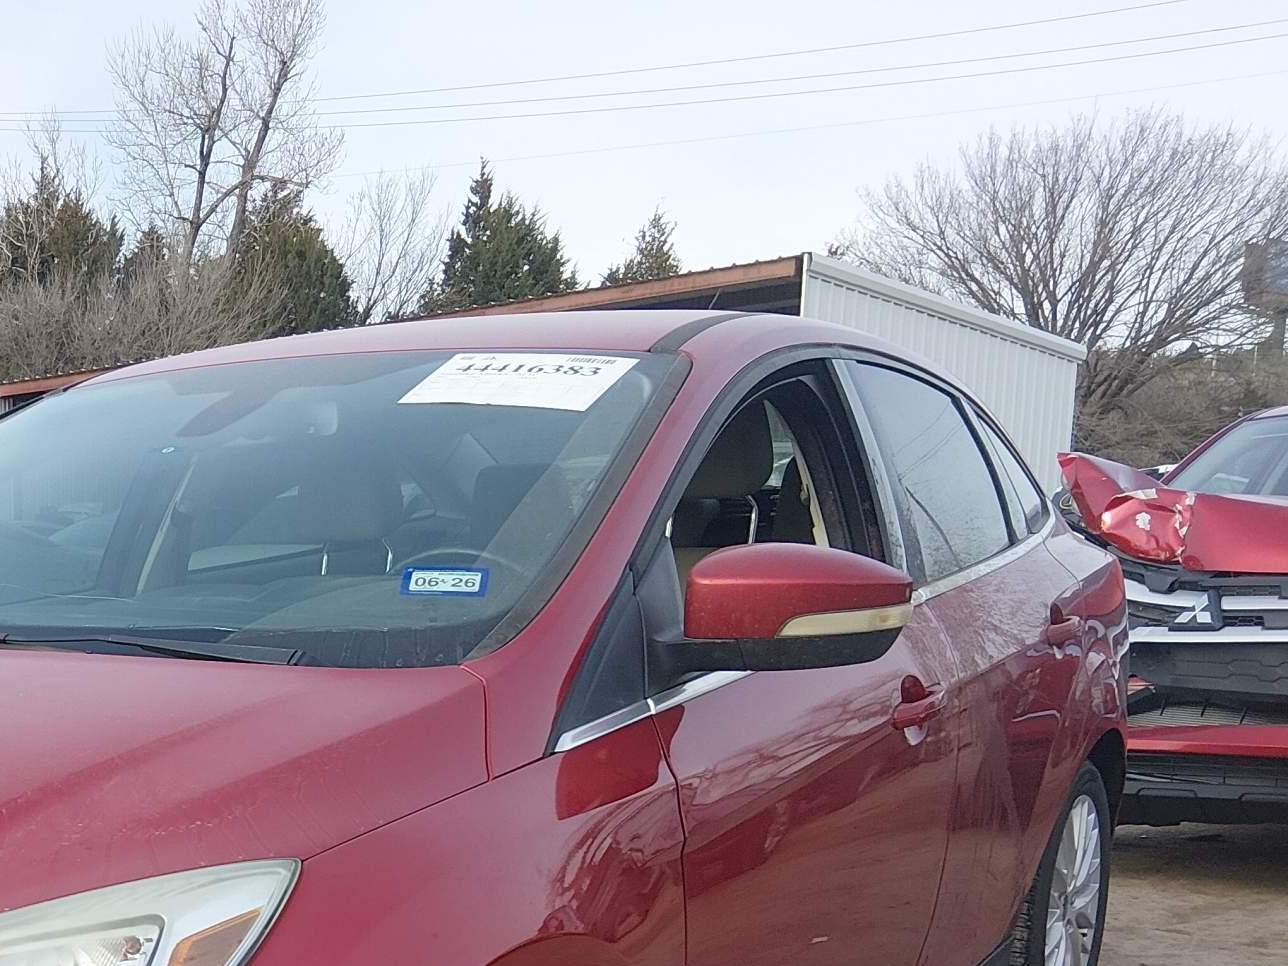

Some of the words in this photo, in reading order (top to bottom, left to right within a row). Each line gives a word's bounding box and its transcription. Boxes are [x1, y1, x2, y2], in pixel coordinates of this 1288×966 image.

[456, 363, 601, 376] 44416383
[414, 576, 440, 587] 06
[450, 577, 477, 588] 26
